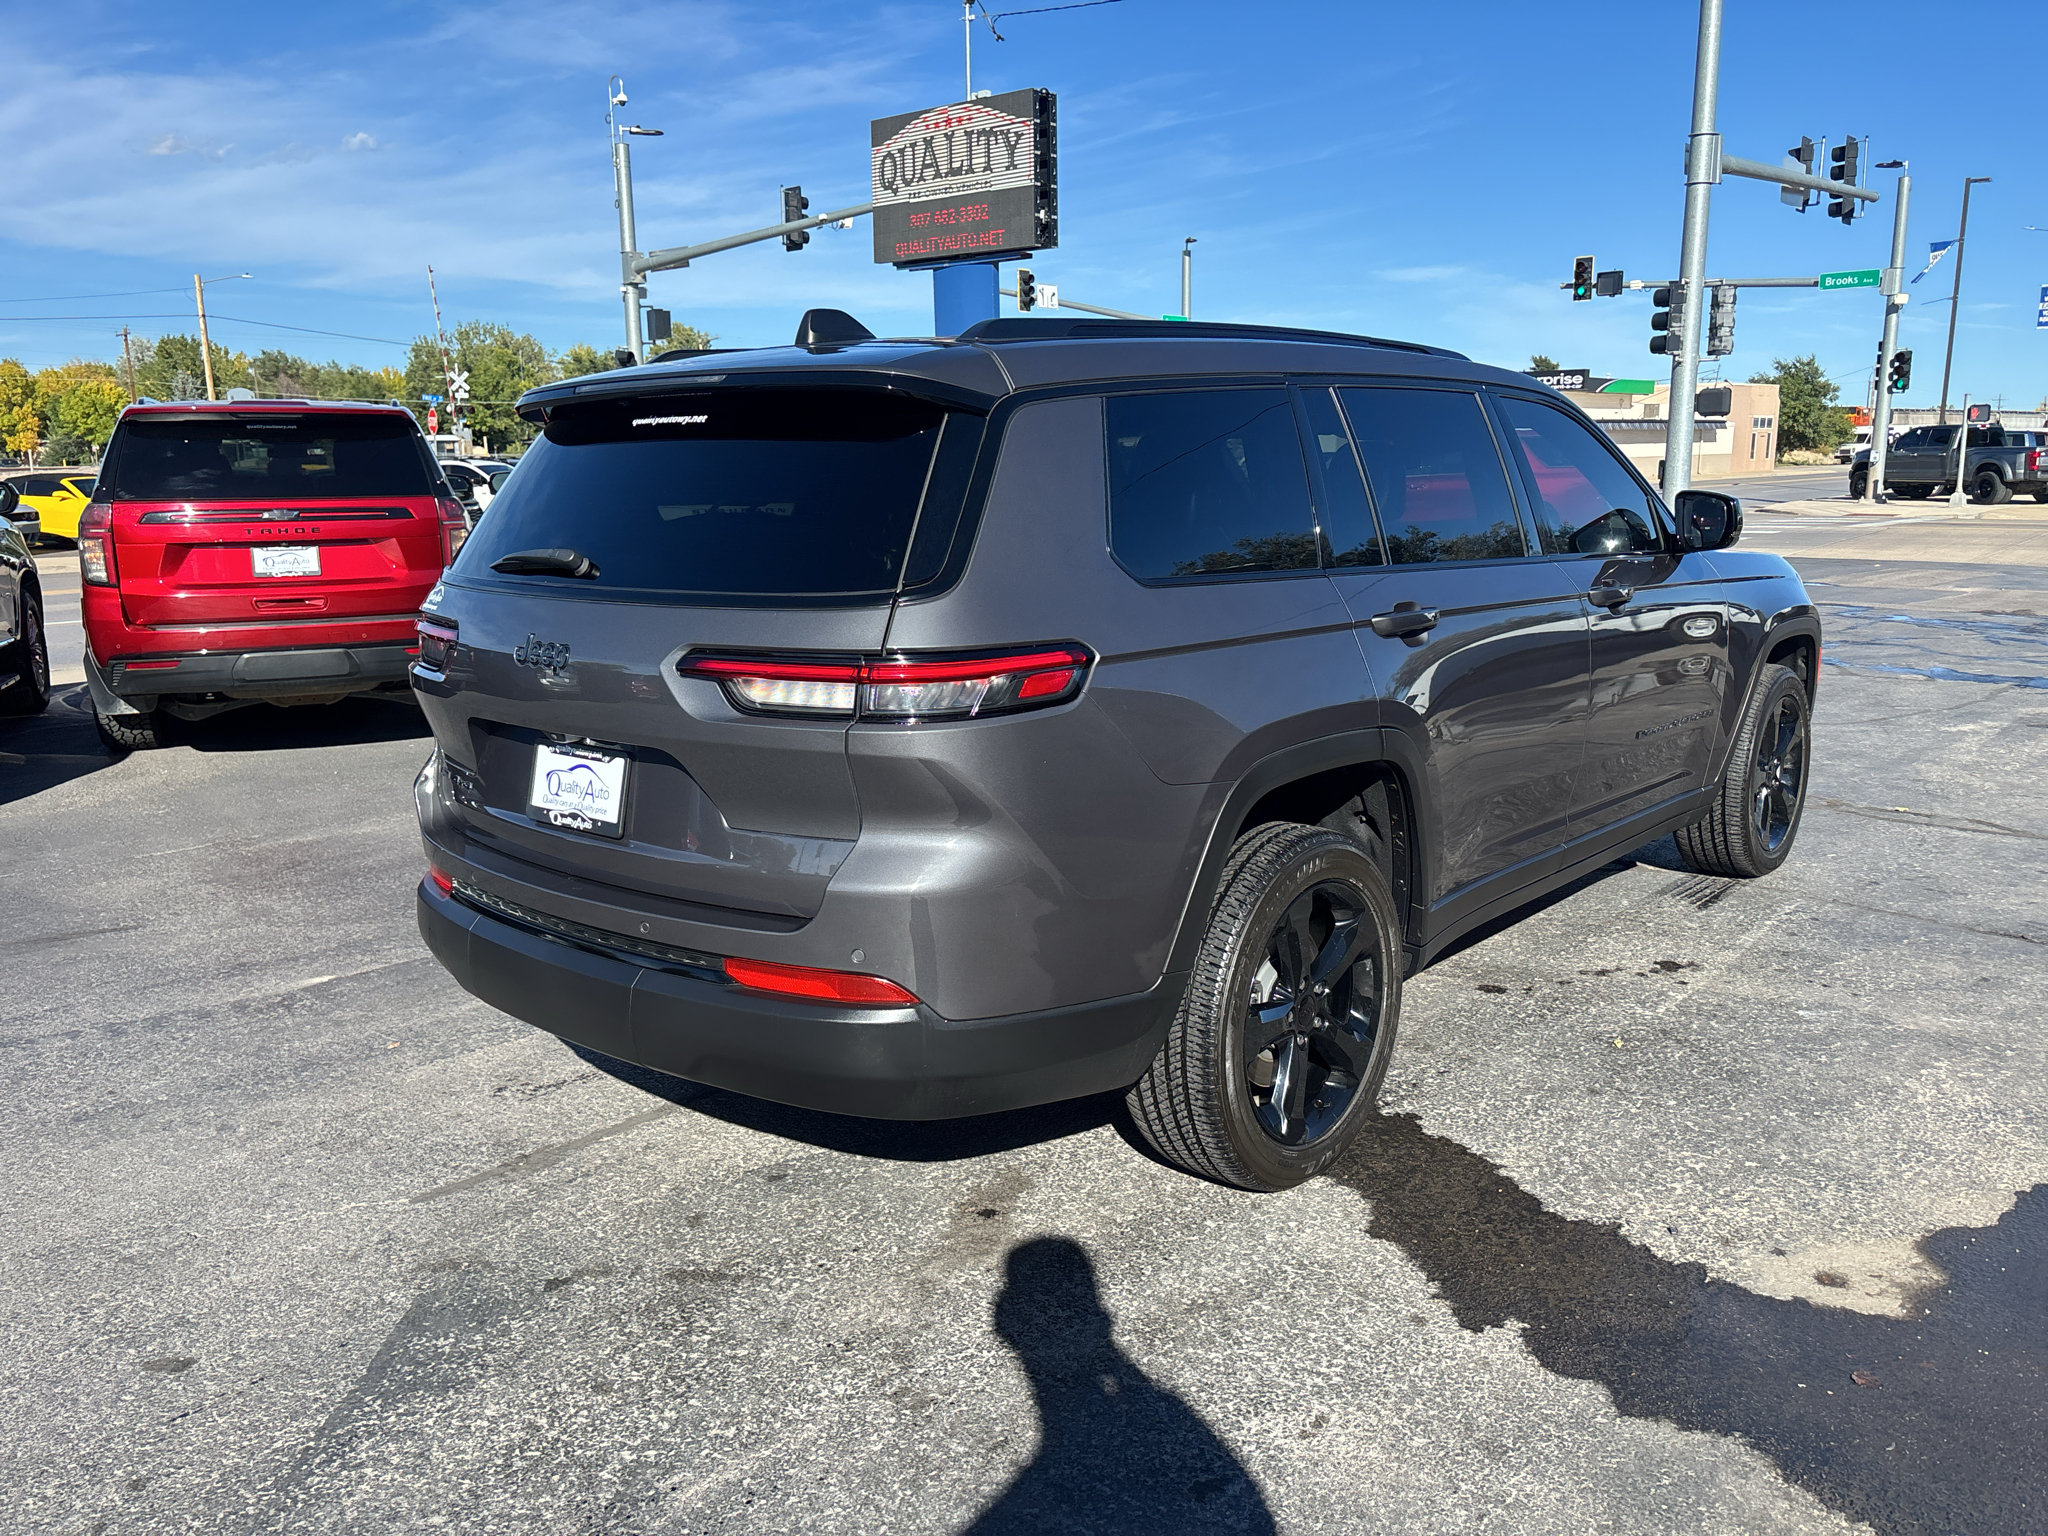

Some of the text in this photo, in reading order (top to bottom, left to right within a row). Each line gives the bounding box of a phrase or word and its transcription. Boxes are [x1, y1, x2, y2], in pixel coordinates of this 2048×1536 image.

[879, 127, 1025, 196] QUALITY
[896, 229, 1005, 258] QUALITYAUTO.NET
[1825, 275, 1858, 286] Brooks
[243, 527, 321, 535] TAHOE
[513, 631, 571, 676] Jeep
